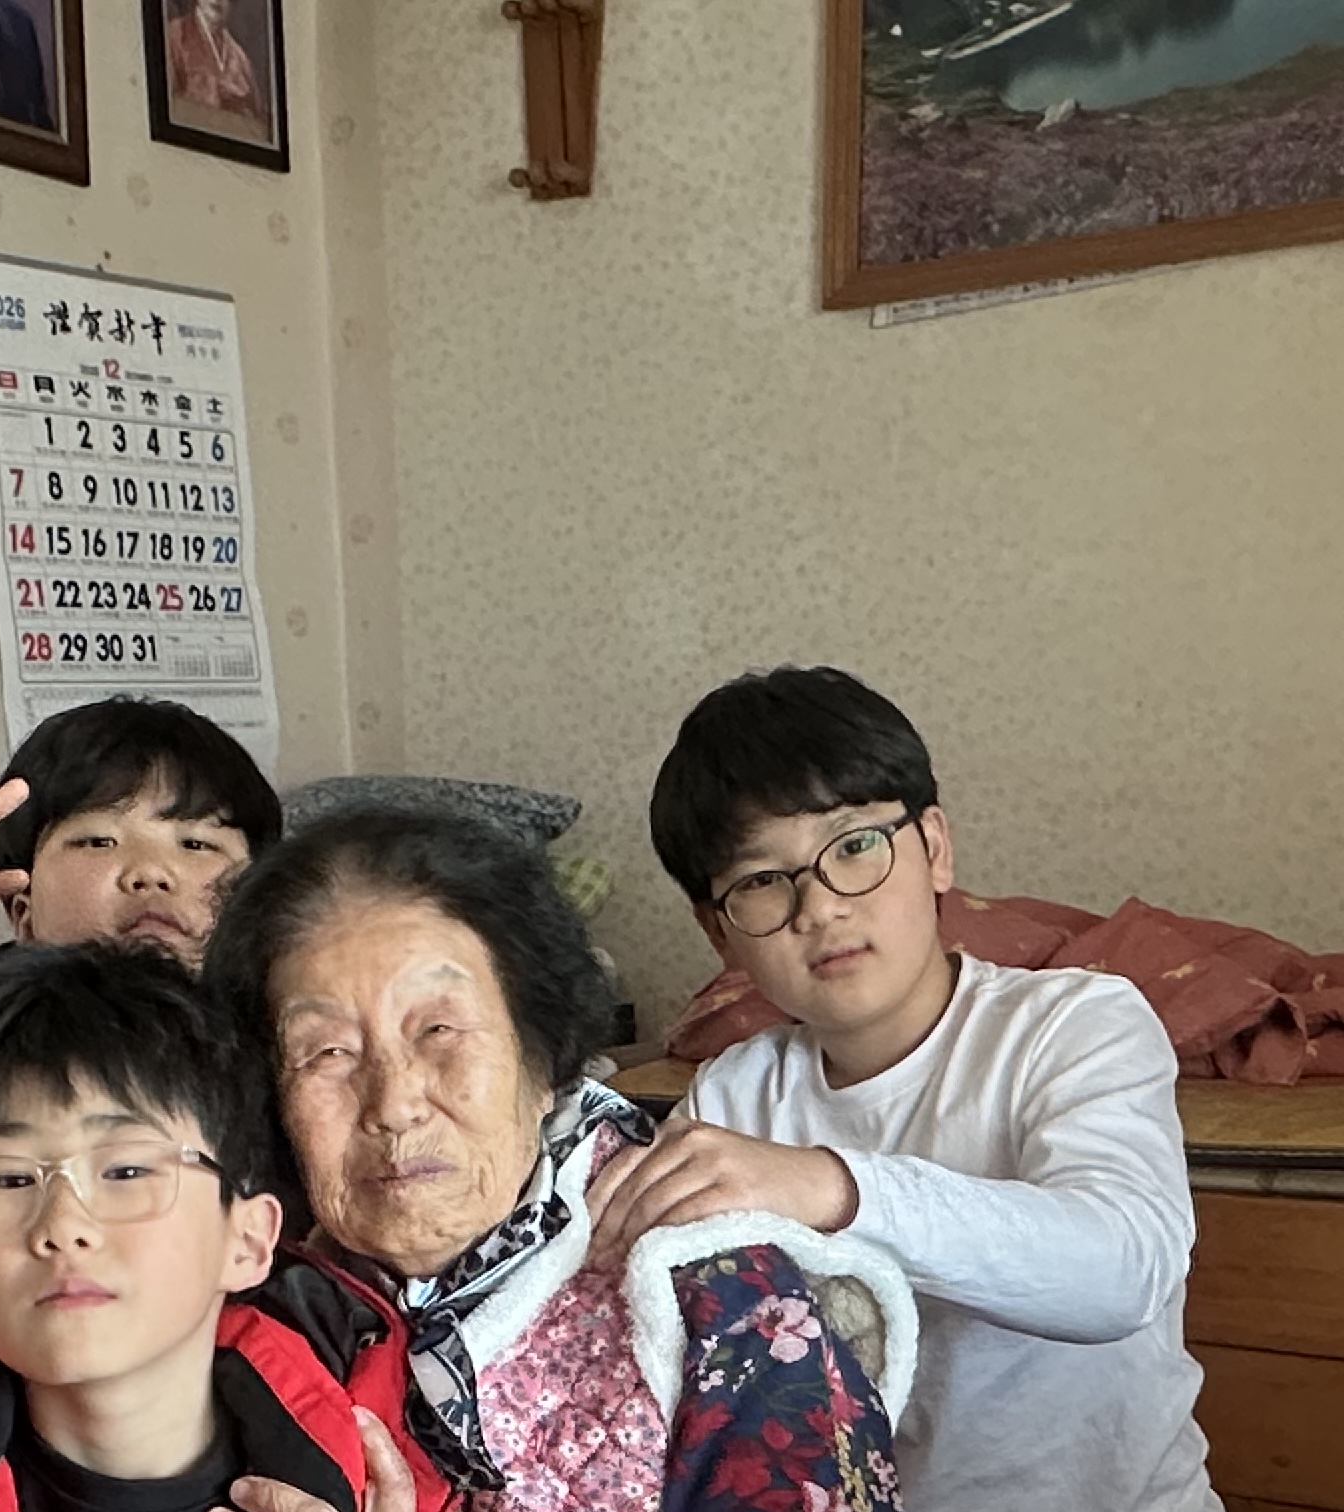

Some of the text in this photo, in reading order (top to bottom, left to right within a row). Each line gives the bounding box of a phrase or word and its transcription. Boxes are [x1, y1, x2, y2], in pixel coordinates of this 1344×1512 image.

[102, 358, 121, 379] 12
[33, 374, 55, 394] 月
[69, 380, 92, 399] 火
[105, 384, 127, 402] 水
[140, 389, 160, 407] 木
[174, 393, 192, 412] 金
[207, 397, 225, 416] 土
[44, 416, 225, 462] 1 2 3 4 5 6
[9, 468, 235, 514] 7 8 9 10 11 12 13
[9, 523, 238, 564] 14 15 16 17 18 19 20
[16, 578, 242, 613] 21 22 23 24 25 26 27
[22, 632, 53, 662] 28
[58, 632, 88, 662] 29
[95, 633, 124, 662] 30
[132, 634, 158, 662] 31
